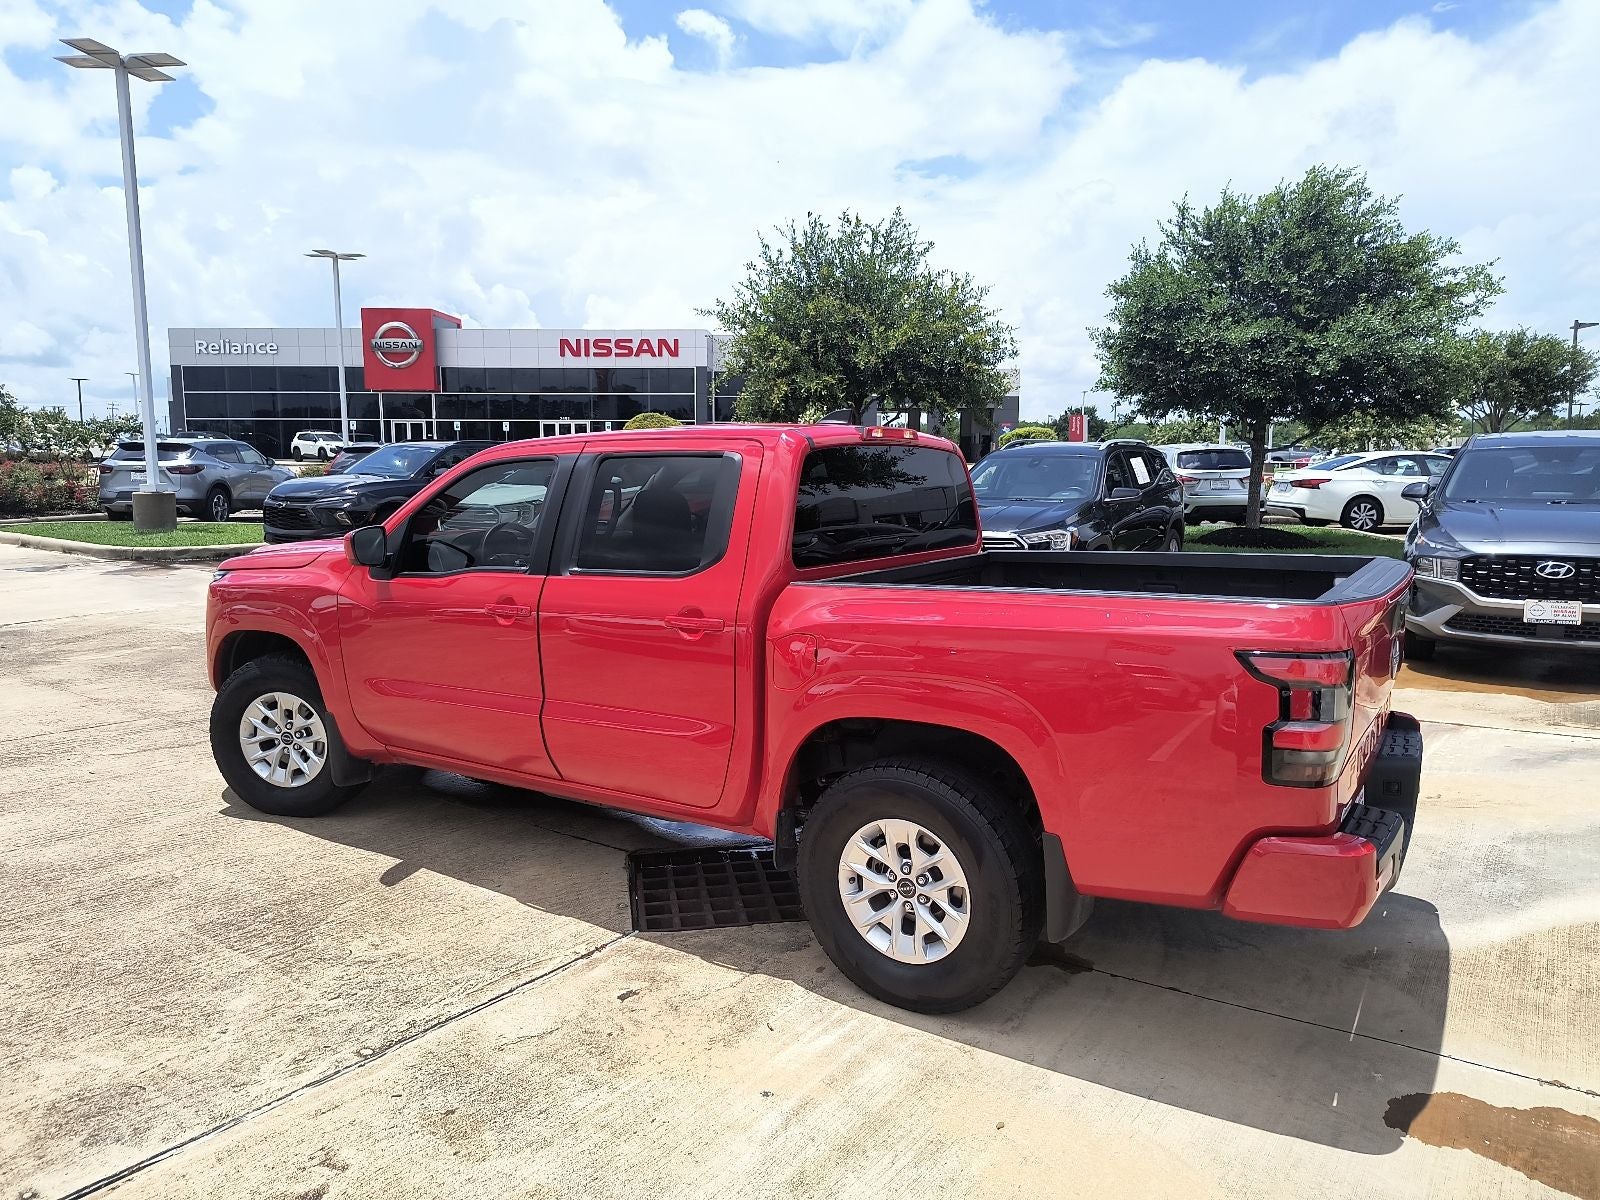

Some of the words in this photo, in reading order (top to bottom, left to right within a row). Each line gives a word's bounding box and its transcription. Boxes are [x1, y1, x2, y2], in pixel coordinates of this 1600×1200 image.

[195, 339, 278, 355] Reliance
[374, 341, 418, 349] NISSAN
[559, 338, 679, 358] NISSAN
